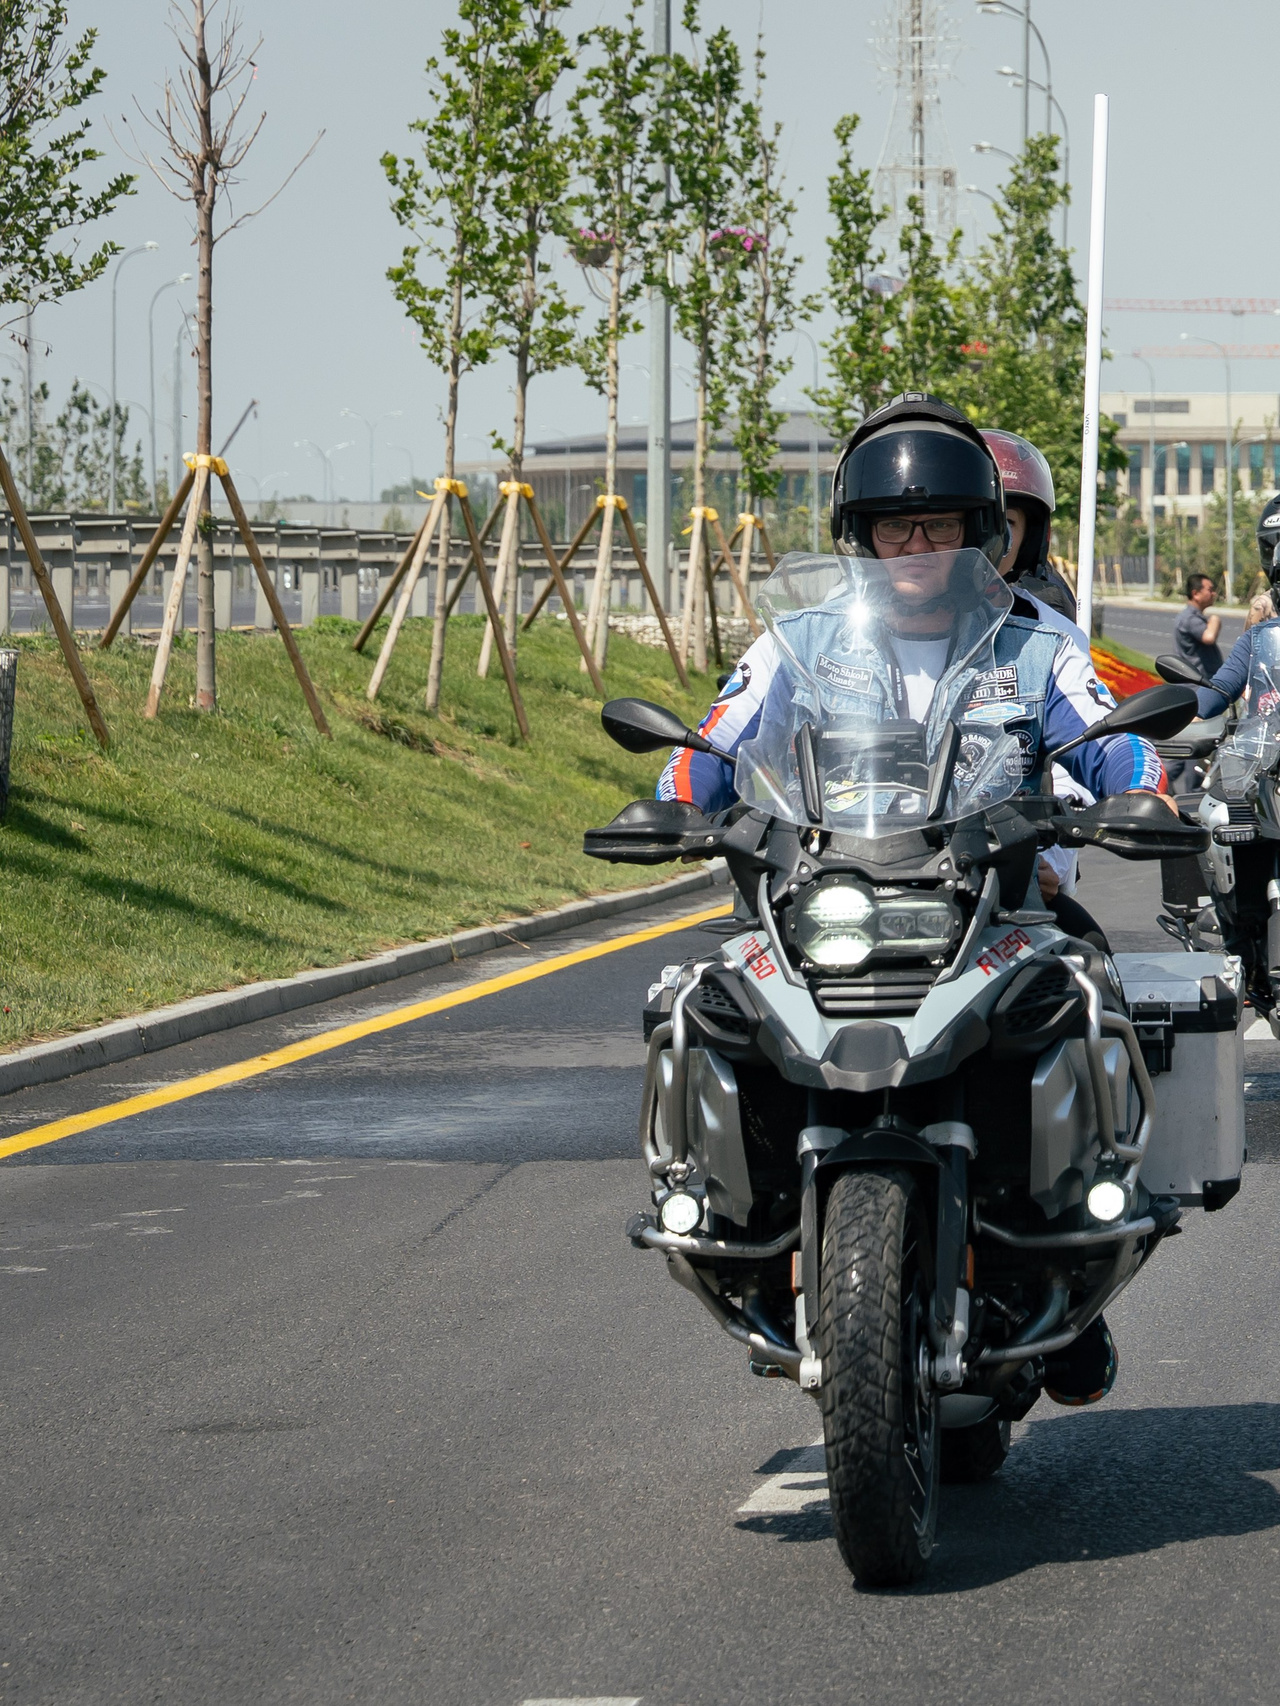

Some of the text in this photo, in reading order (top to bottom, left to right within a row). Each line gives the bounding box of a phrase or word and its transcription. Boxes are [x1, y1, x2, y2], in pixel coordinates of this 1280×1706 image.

[818, 657, 869, 681] Moto Shkola
[827, 673, 857, 688] Almaty
